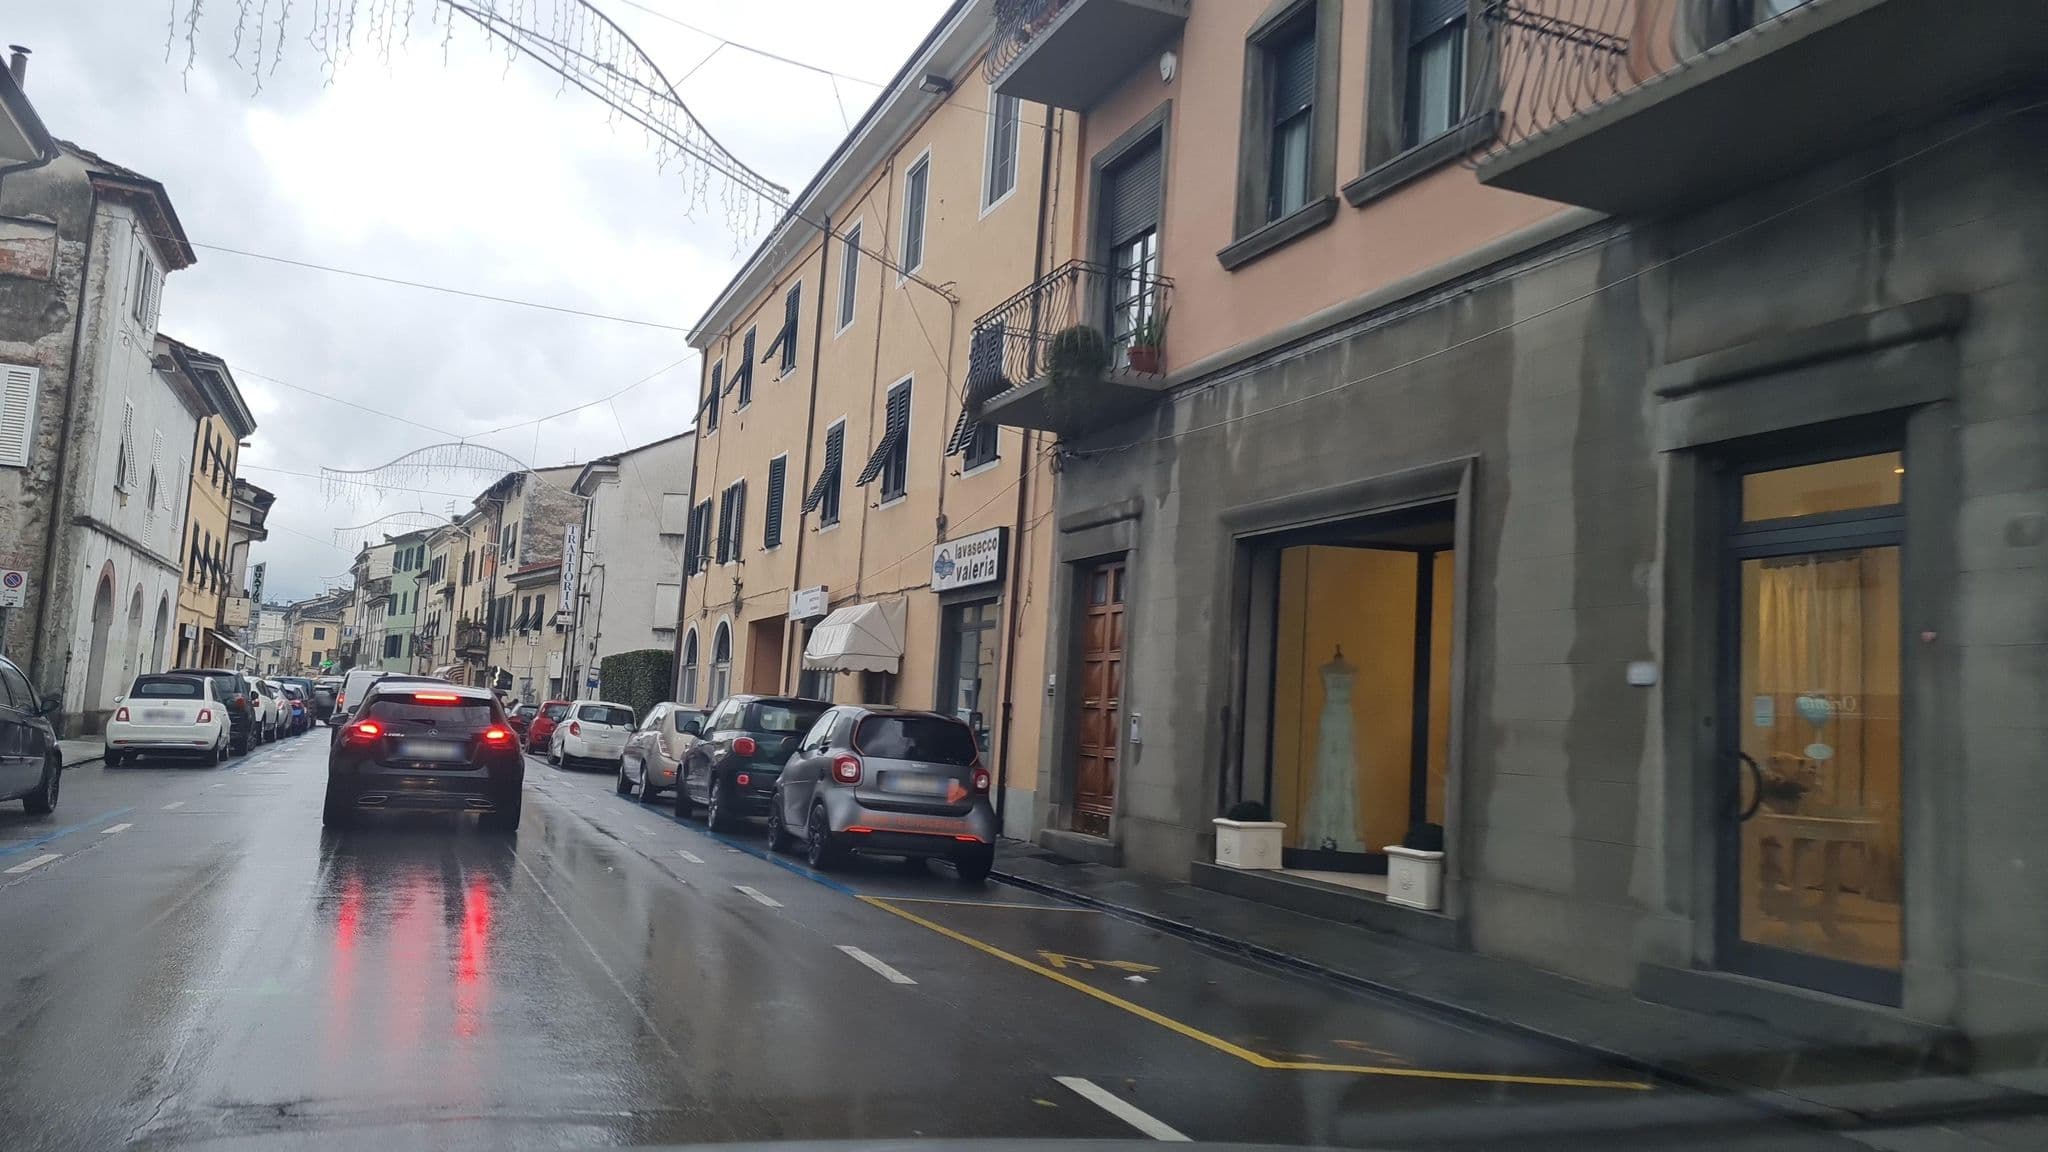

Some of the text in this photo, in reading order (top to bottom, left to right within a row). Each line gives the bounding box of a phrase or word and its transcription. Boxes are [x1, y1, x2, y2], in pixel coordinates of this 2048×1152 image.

[955, 537, 997, 560] lavasecco
[562, 525, 578, 610] TRATTORIA
[956, 555, 995, 582] valeria
